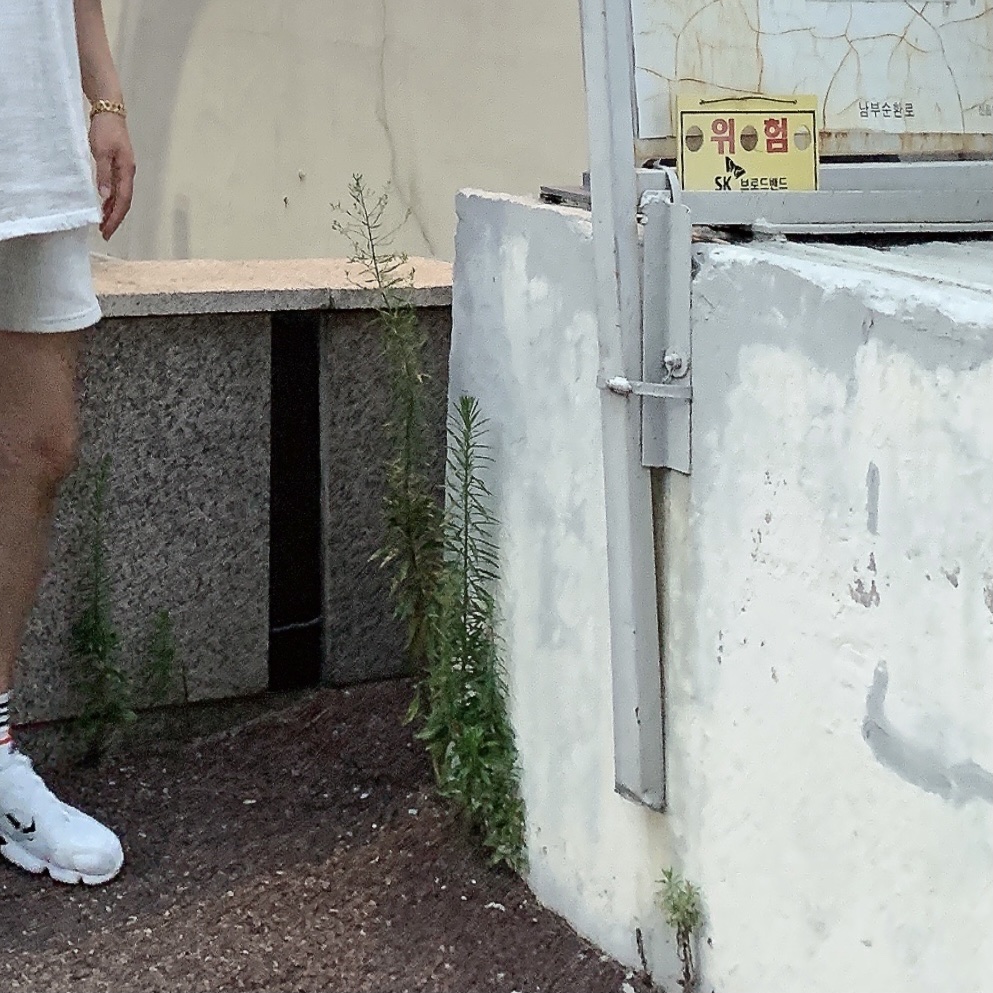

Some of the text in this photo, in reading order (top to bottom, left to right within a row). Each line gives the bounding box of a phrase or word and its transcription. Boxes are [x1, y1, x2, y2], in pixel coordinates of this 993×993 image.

[859, 101, 914, 118] 남부순환로
[710, 118, 788, 154] 위험
[715, 176, 788, 190] SK 브로드밴드
